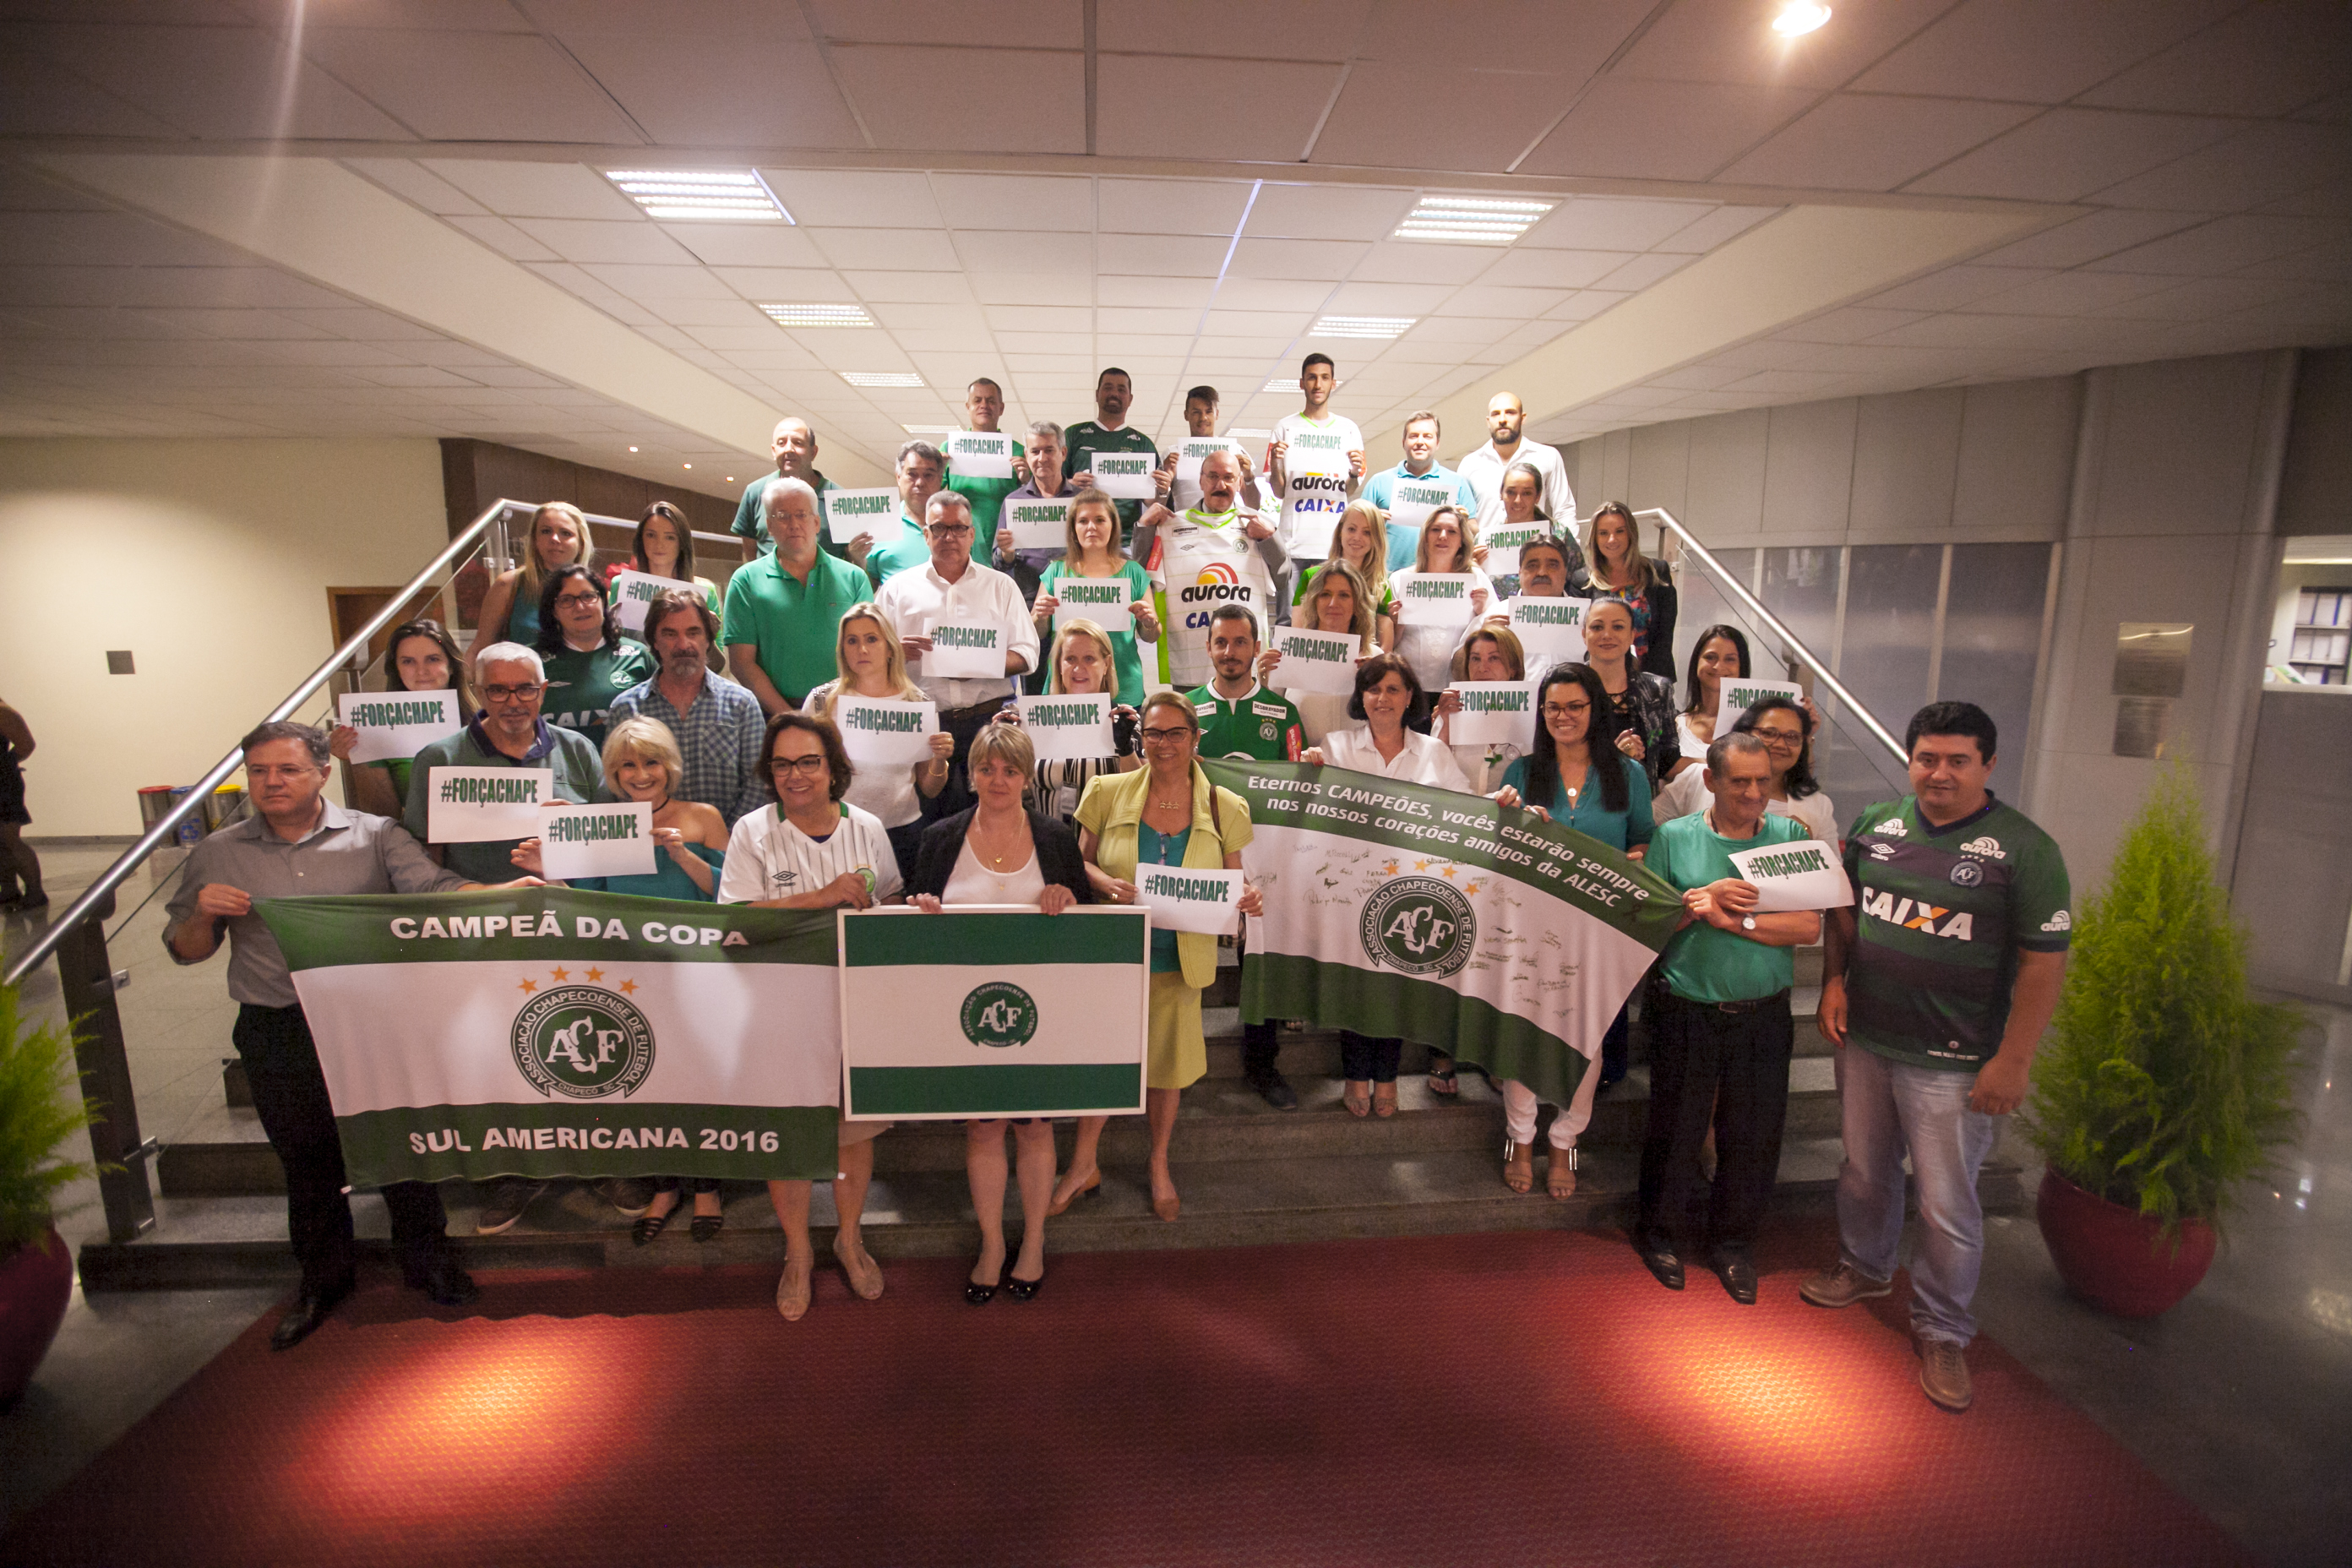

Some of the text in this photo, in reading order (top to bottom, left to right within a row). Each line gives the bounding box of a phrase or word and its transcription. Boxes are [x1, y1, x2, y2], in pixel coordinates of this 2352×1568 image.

[954, 438, 1004, 459] #FORÇACHAPE
[1294, 434, 1341, 450] #FORÇACHAPE
[1097, 460, 1147, 477] #FORÇACHAPE
[832, 495, 890, 519] #FORÇACHAPE
[1295, 498, 1345, 513] CAIXA
[1397, 487, 1448, 507] #FORÇACHAPE
[1012, 505, 1067, 526] #FORÇACHAPE
[1061, 585, 1121, 607] #FORÇACHAPE
[1181, 585, 1251, 602] aurora
[1406, 580, 1464, 601] #FORÇACHAPE
[1515, 604, 1580, 628] #FORÇACHAPE
[930, 625, 997, 651] #FORÇACHAPE
[1280, 635, 1348, 663] #FORÇACHAPE
[350, 700, 445, 732] #FORÇACHAPE
[846, 706, 923, 734] #FORÇACHAPE
[1027, 703, 1100, 730] #FORÇACHAPE
[441, 777, 538, 808] #FORÇACHAPE
[548, 814, 638, 847] #FORÇACHAPE
[1248, 775, 1651, 901] Eternos CAMPEÕES, vocês estarão sempre
[1267, 798, 1623, 908] nos nossos corações amigos da ALESC
[1748, 849, 1830, 879] #FORÇACHAPE
[1960, 842, 2006, 859] aurora
[1145, 874, 1229, 903] #FORÇACHAPE
[1390, 880, 1467, 915] CHAPECOENSE
[1365, 891, 1390, 954] ASSOCIAÇÃO
[1462, 916, 1472, 931] DE
[1862, 886, 1973, 941] CAIXA
[390, 910, 749, 947] CAMPEÃ DA COPA
[1443, 933, 1471, 971] FUTEBOL
[517, 991, 649, 1086] ASSOCIAÇÃO CHAPECOENSE DE FUTEBOL
[602, 1083, 615, 1092] SC
[409, 1127, 780, 1155] SUL AMERICANA 2016
